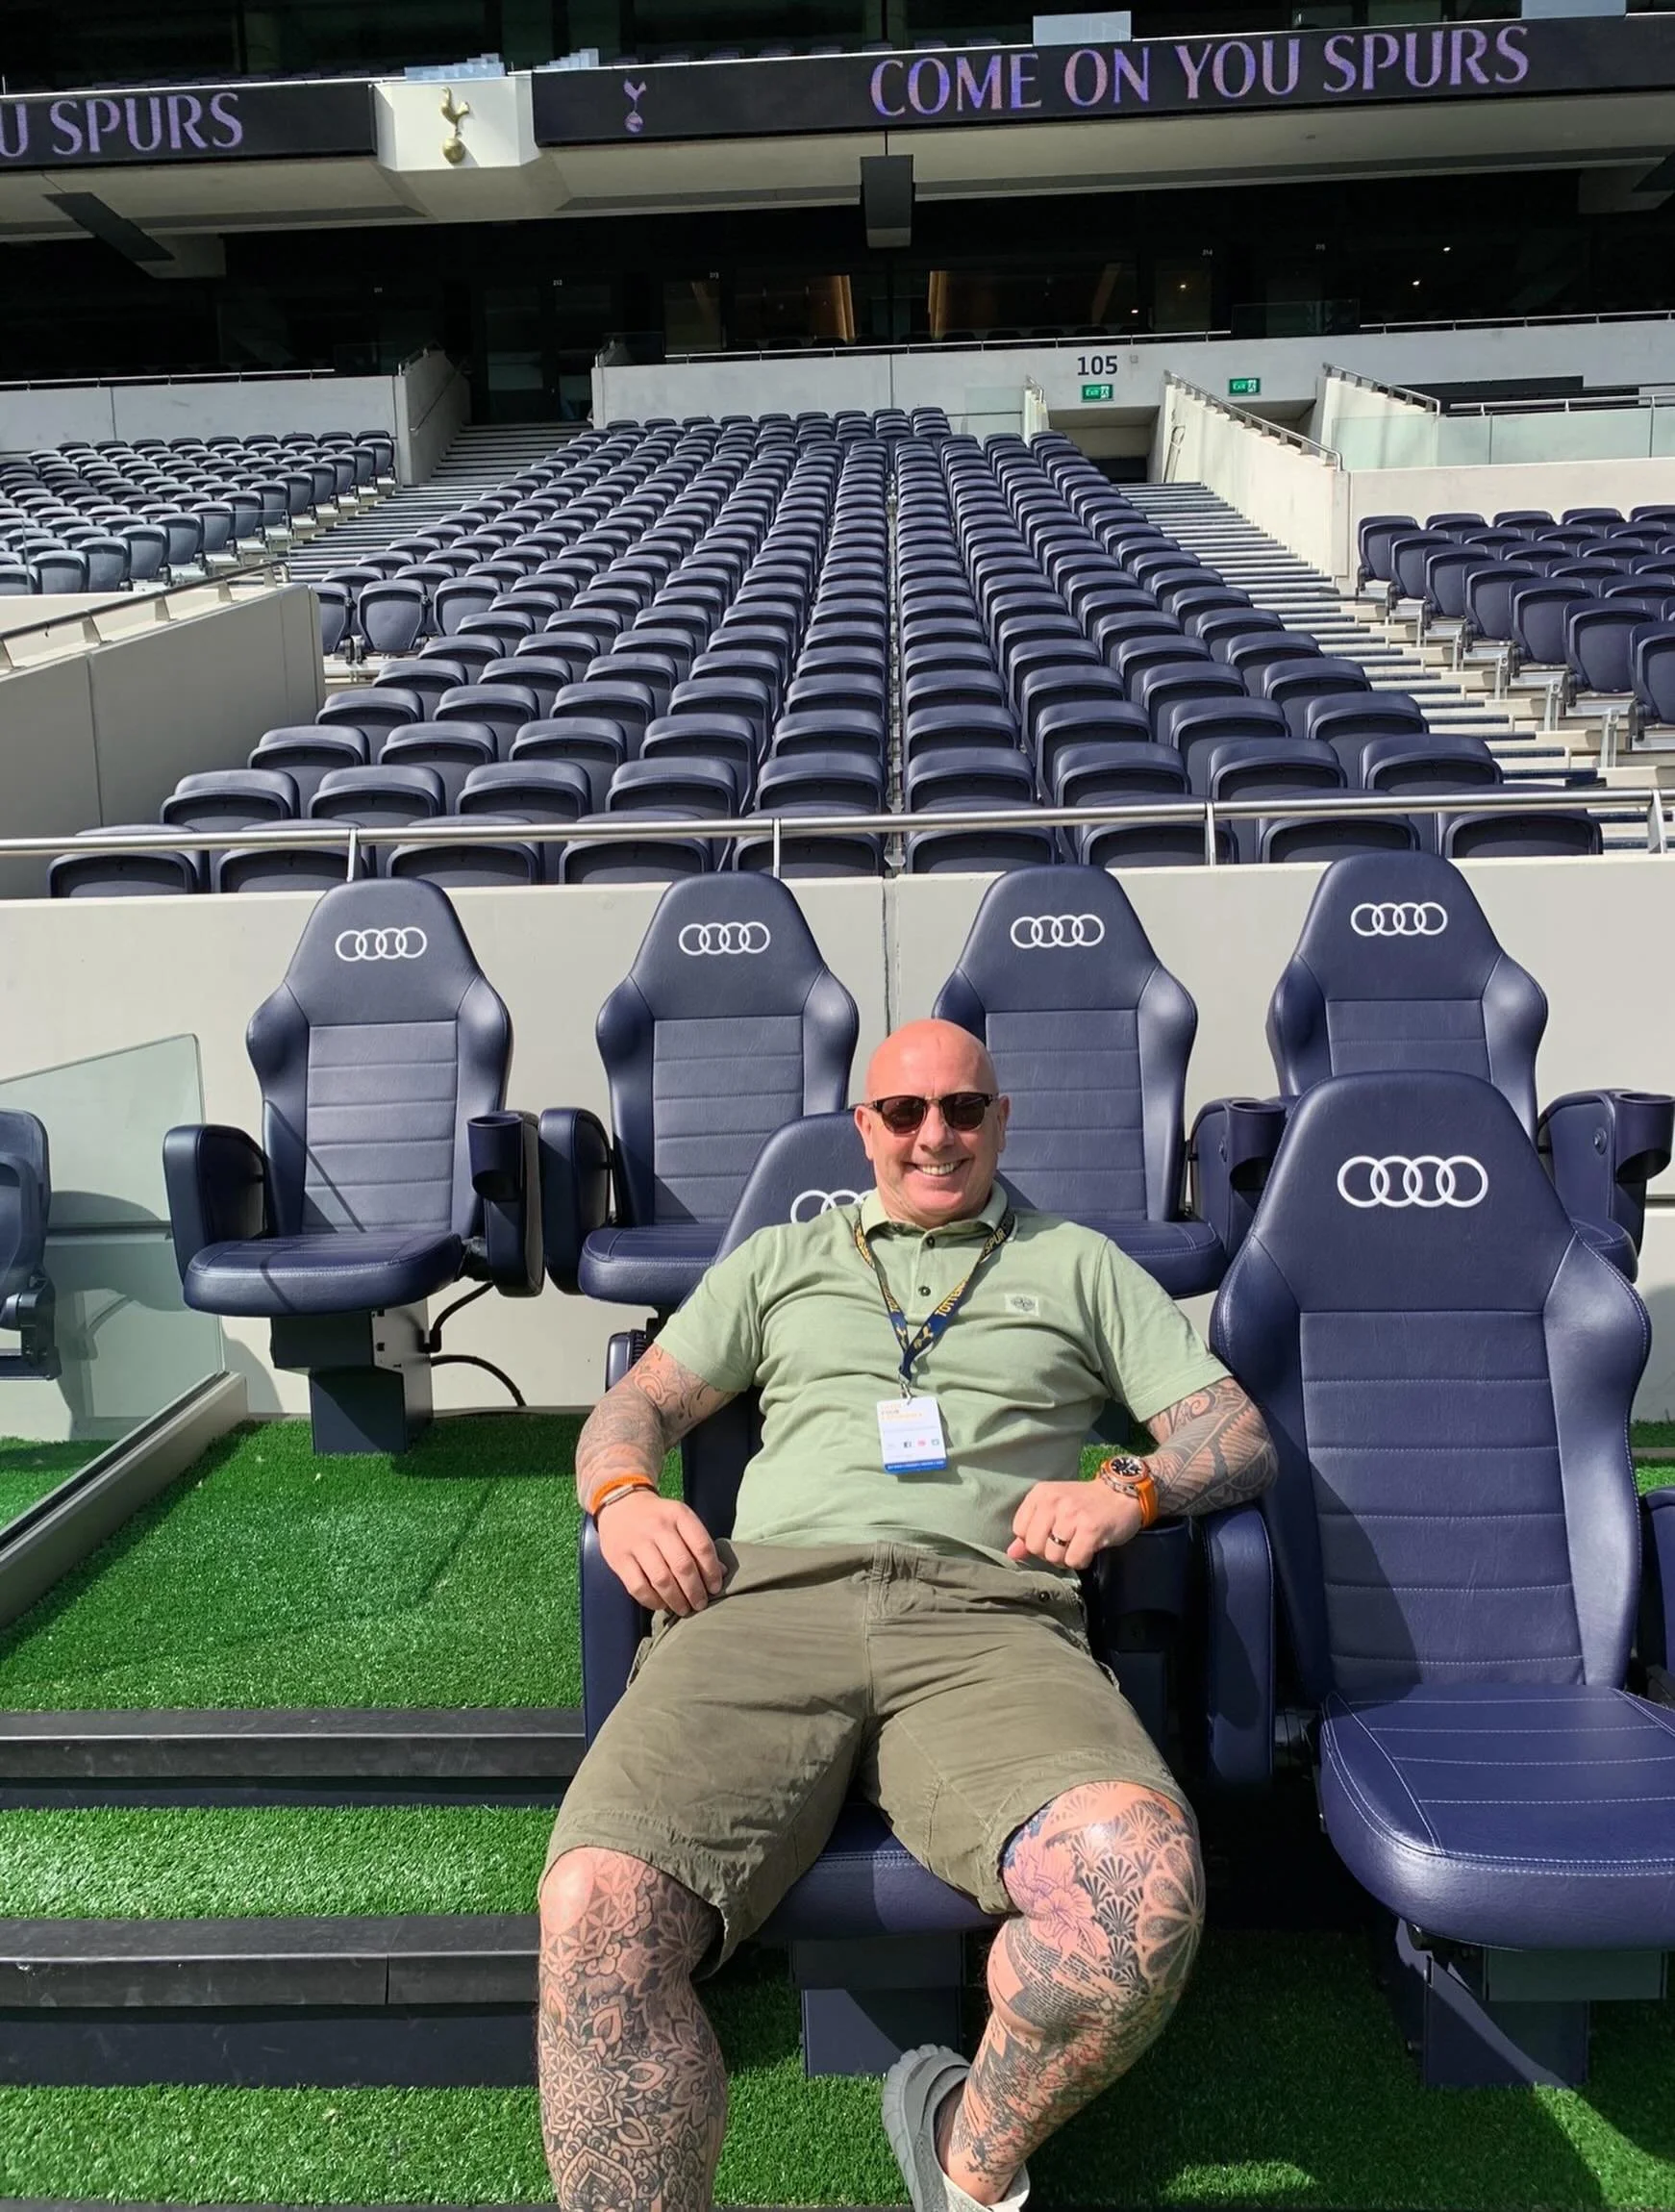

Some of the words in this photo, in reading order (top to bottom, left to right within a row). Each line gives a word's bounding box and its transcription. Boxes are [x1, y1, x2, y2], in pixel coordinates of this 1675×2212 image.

[870, 53, 1041, 116] COME
[1064, 46, 1150, 107] ON
[1174, 38, 1301, 99] YOU
[1323, 27, 1530, 92] SPURS
[50, 92, 243, 155] SPURS
[1077, 355, 1117, 376] 105
